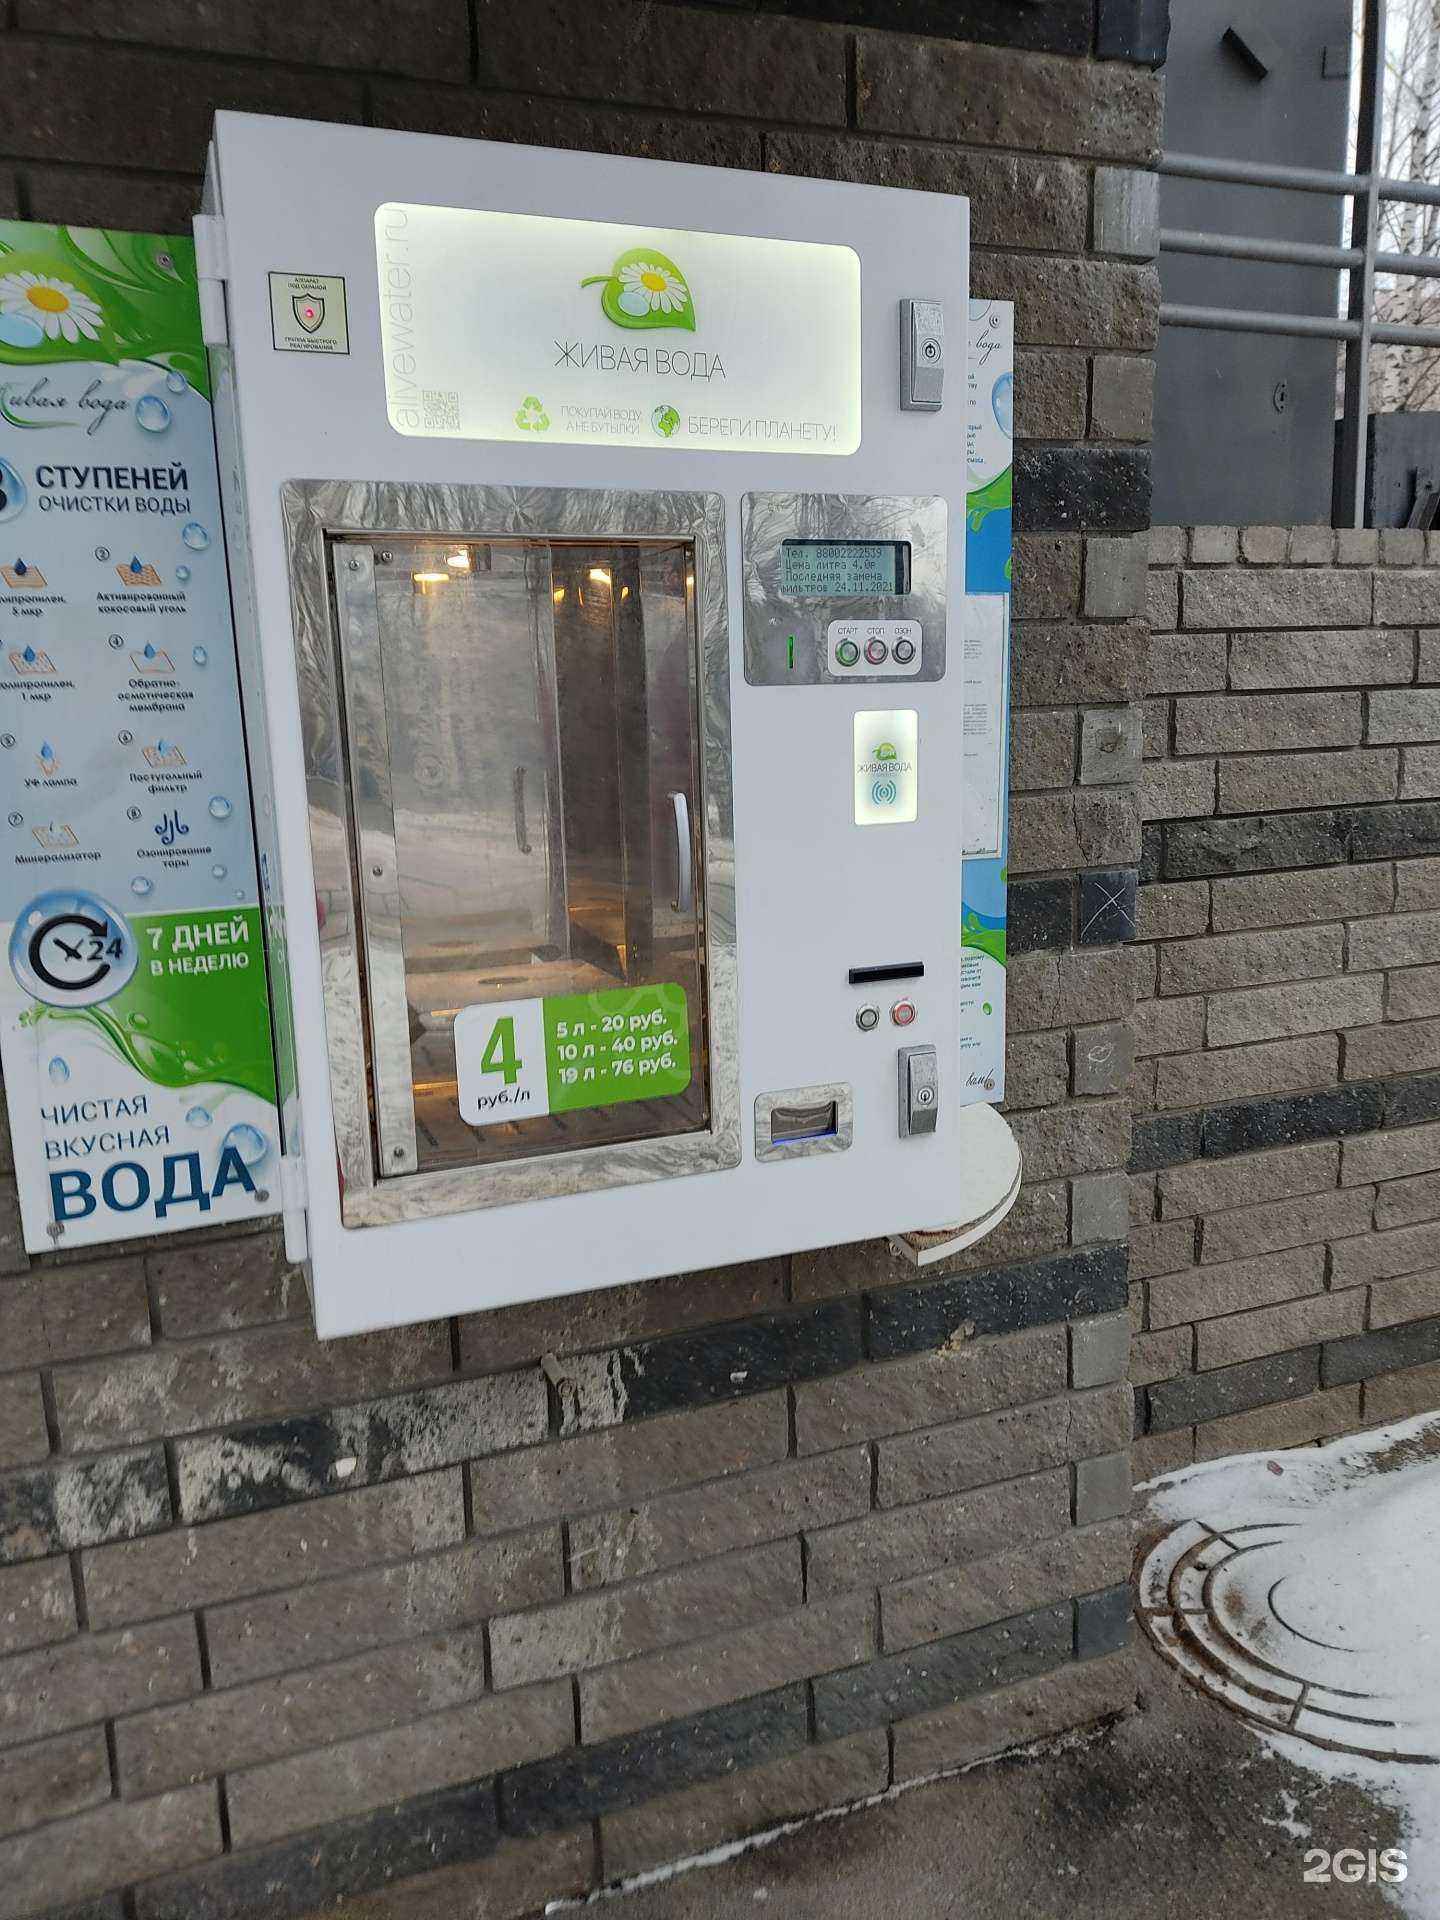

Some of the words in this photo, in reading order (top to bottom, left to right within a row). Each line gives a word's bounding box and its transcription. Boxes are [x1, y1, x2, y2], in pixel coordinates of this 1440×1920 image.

[553, 339, 649, 373] ЖИВАЯ
[655, 349, 727, 382] ВОДА
[561, 405, 613, 419] ПОКУПАЙ
[613, 409, 642, 421] ВОДУ
[576, 424, 589, 432] НЕ
[592, 424, 640, 435] БУТЫЛКИ
[688, 415, 751, 437] БЕРЕГИ
[755, 420, 838, 441] ПЛАНЕТУ!
[36, 462, 188, 491] СТУПЕНЕЙ
[39, 494, 129, 513] ОЧИСТКИ
[136, 496, 191, 516] ВОДЫ
[786, 560, 811, 571] Цена
[816, 561, 847, 570] литра
[786, 571, 841, 582] Последняя
[847, 573, 882, 581] замена
[86, 936, 123, 961] 24
[147, 927, 162, 951] 7
[172, 916, 249, 954] ДНЕЙ
[151, 960, 164, 977] В
[168, 951, 249, 977] НЕДЕЛЮ
[556, 1021, 568, 1039] 5
[572, 1022, 585, 1037] л
[601, 1014, 625, 1033] 20
[629, 1007, 668, 1034] руб.
[481, 1016, 523, 1085] 4
[557, 1043, 578, 1062] 10
[582, 1043, 595, 1058] л
[611, 1035, 636, 1054] 40
[640, 1029, 678, 1056] руб.
[558, 1066, 578, 1085] 19
[582, 1066, 595, 1081] л
[612, 1058, 634, 1076] 76
[638, 1052, 677, 1077] руб.
[41, 1094, 148, 1127] ЧИСТАЯ
[476, 1086, 531, 1111] руб./л
[45, 1125, 170, 1161] ВКУСНАЯ
[49, 1143, 257, 1223] ВОДА
